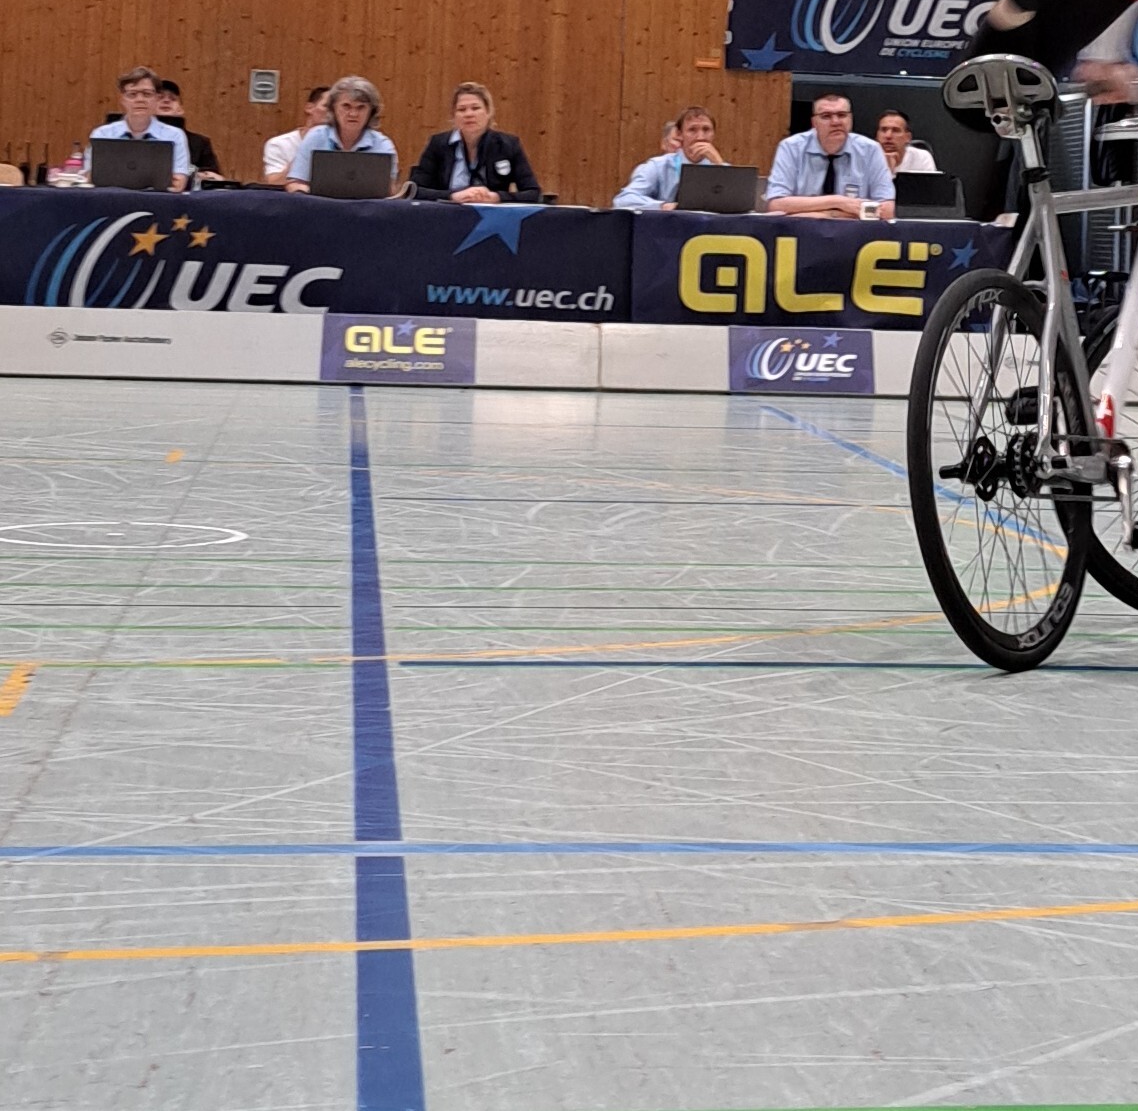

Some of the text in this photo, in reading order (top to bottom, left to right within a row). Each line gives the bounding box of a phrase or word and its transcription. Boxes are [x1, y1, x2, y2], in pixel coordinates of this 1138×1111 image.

[168, 260, 344, 314] UEC
[426, 284, 615, 312] www.uec.ch
[343, 357, 445, 372] alecycling.com
[794, 353, 858, 373] UEC
